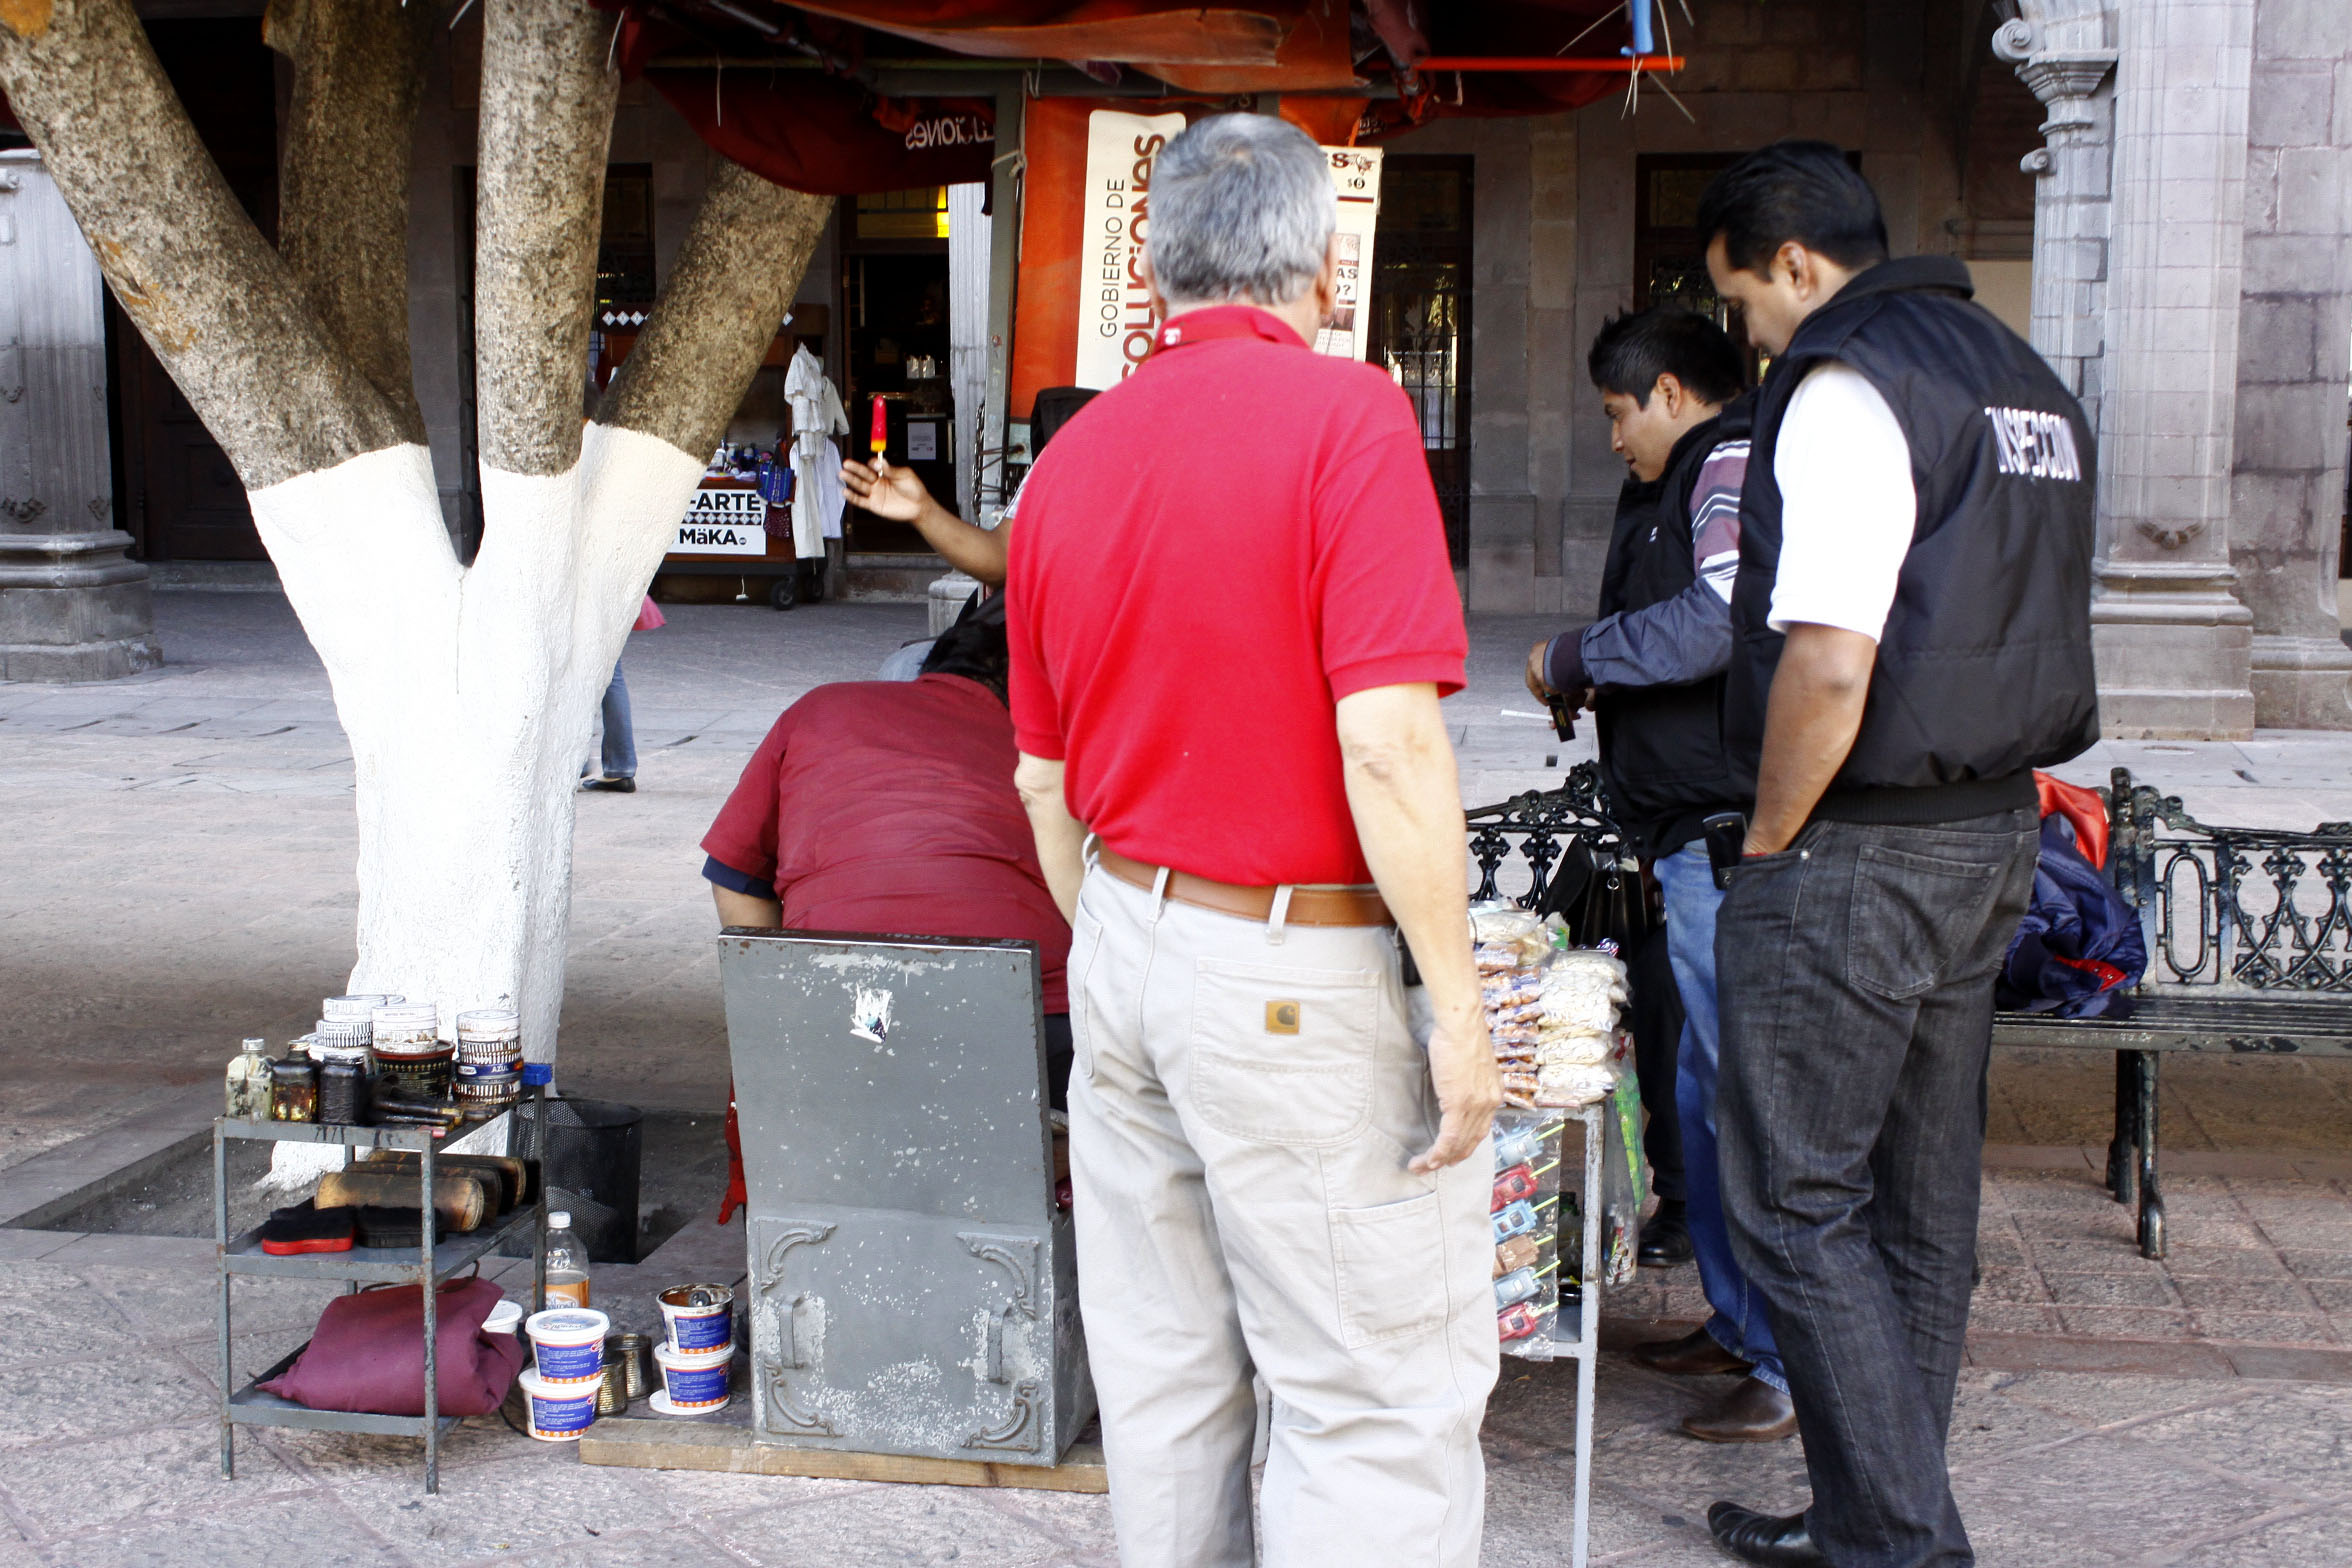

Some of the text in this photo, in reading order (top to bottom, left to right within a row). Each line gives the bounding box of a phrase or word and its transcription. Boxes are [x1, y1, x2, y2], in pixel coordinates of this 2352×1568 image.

[1100, 178, 1125, 339] GOBIERNO DE
[490, 1064, 509, 1073] AZUL
